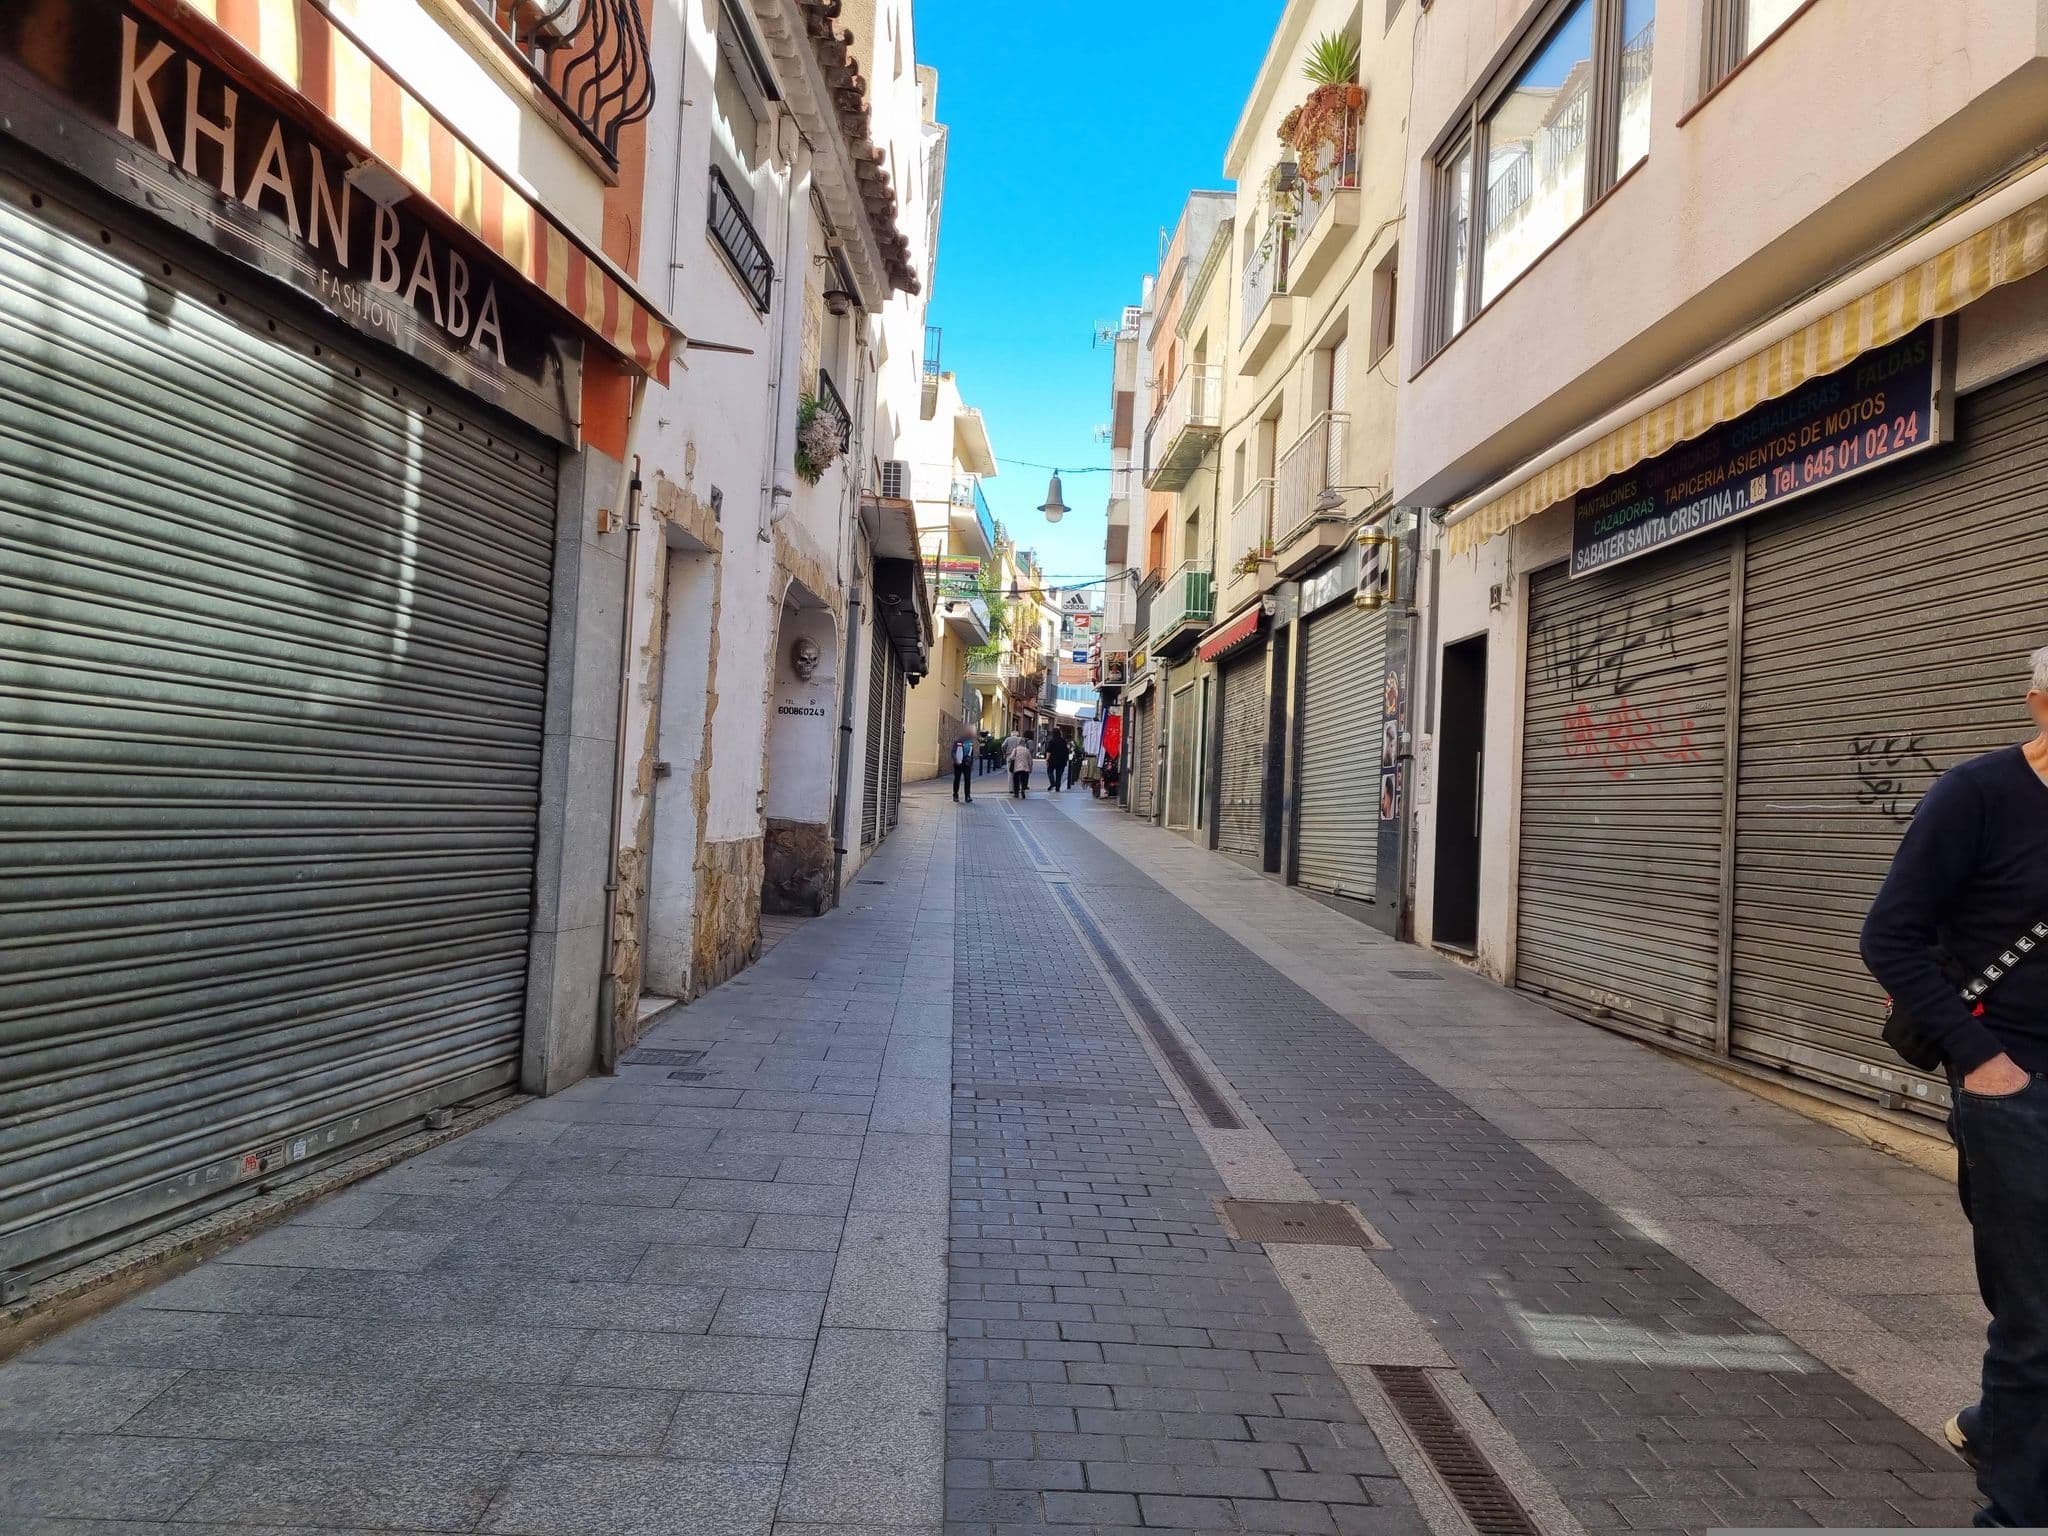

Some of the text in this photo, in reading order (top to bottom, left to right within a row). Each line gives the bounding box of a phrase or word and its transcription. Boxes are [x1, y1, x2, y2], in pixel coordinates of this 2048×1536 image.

[117, 14, 507, 367] KHAN BABA
[320, 268, 399, 335] FASHION
[1577, 480, 1638, 520] PANTALONES
[1855, 341, 1928, 391] FALDAS
[1577, 533, 1625, 570] SABATER
[1627, 516, 1667, 547] SANTA
[1669, 488, 1733, 536] CRISTINA
[1772, 461, 1799, 494] Tel.
[1803, 445, 1836, 483] 645
[1838, 435, 1859, 469] 01
[1865, 423, 1889, 460] 02
[1893, 410, 1918, 449] 24
[1594, 392, 1886, 536] CAZADORAS TAPICERIA ASIENTOS DE MOTOS
[778, 706, 825, 716] 600860249
